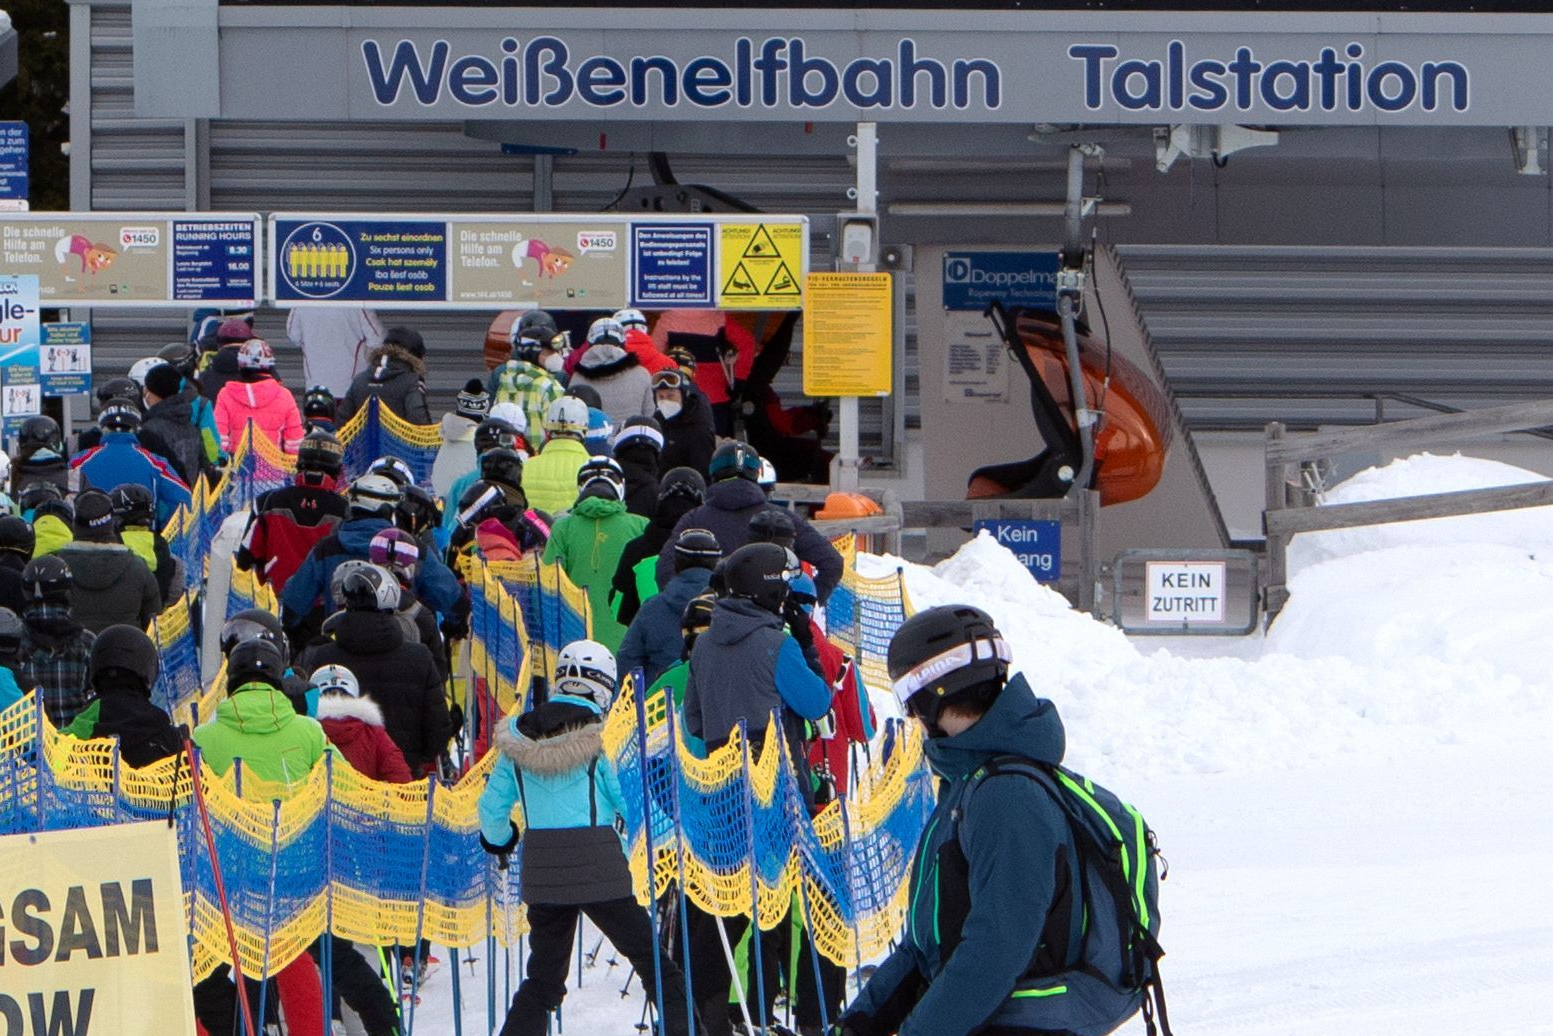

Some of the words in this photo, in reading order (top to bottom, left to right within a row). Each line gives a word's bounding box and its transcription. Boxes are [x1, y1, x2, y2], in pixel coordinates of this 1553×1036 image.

[360, 35, 1002, 111] Weißenelfbahn
[1067, 39, 1470, 113] Talstation
[8, 128, 22, 136] der
[4, 226, 20, 237] Die
[23, 226, 64, 237] schnelle
[176, 223, 251, 232] BETRIEBSZEITEN
[132, 235, 156, 243] 1450
[176, 232, 217, 240] RUNNING
[219, 232, 251, 240] HOURS
[312, 227, 322, 241] 6
[360, 232, 372, 241] Zu
[374, 232, 399, 241] sechst
[401, 232, 443, 242] einordnen
[460, 230, 477, 241] Die
[480, 230, 522, 241] schnelle
[653, 232, 697, 240] Anweisungen
[4, 239, 26, 250] Hilfe
[30, 242, 45, 250] am
[590, 238, 613, 247] 1450
[229, 246, 247, 254] 8.30
[370, 246, 381, 254] Six
[383, 246, 415, 256] persons
[416, 246, 433, 256] only
[460, 243, 484, 254] Hilfe
[487, 246, 502, 254] am
[4, 252, 43, 262] Telefon.
[366, 258, 386, 266] Csak
[388, 258, 402, 266] hat
[461, 256, 499, 267] Telefon.
[228, 262, 249, 270] 16.00
[972, 269, 1058, 286] Doppelma
[968, 288, 1007, 298] Ropeway
[998, 526, 1038, 542] Kein
[1018, 552, 1052, 570] ang
[1162, 574, 1210, 588] KEIN
[1153, 597, 1218, 612] ZUTRITT
